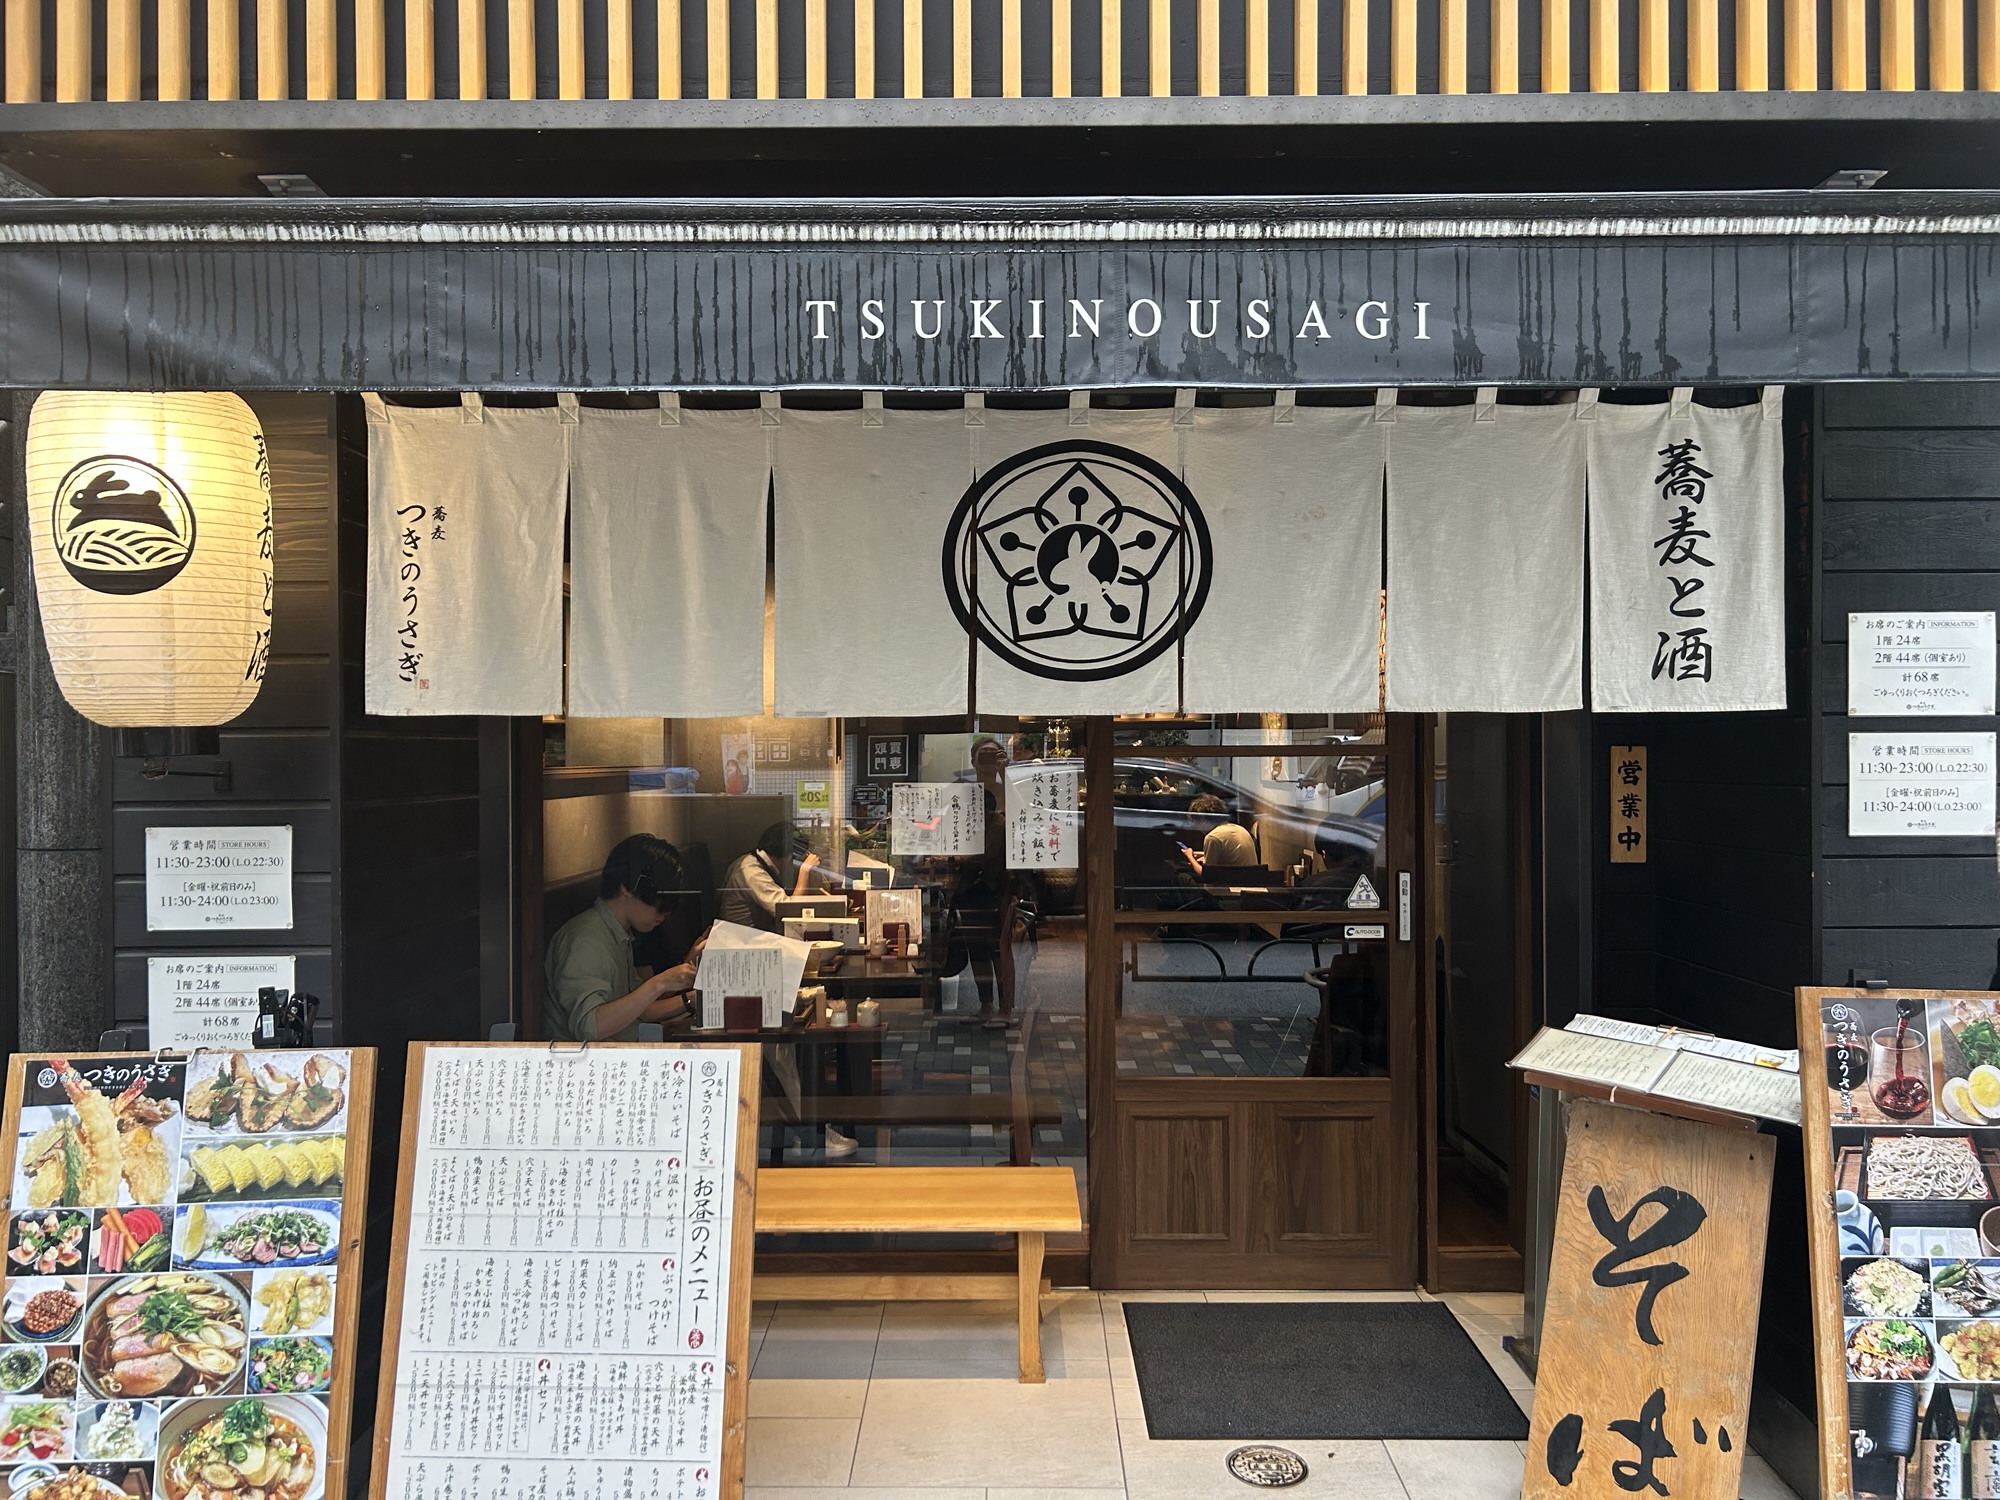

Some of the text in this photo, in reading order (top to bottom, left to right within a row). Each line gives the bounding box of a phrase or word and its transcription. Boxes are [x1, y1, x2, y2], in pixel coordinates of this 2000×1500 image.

[806, 299, 1432, 341] TSUKINOUSAGI
[430, 505, 448, 541] 蕎麦
[1651, 438, 1715, 683] 蕎麦と酒
[396, 503, 427, 682] つきのうさぎ
[1865, 619, 1976, 630] お席のご案内 INFORMATION
[1876, 635, 1921, 646] 1階 24席
[1875, 653, 1892, 663] 2階
[1895, 653, 1920, 663] 44席
[1873, 687, 1969, 698] ごゆっくりおくつろぎください。
[1872, 745, 1920, 757] 営業時間
[1019, 808, 1027, 863] お付けできます
[1032, 773, 1045, 862] 炊き込みご飯を
[1048, 773, 1061, 862] お蕎麦に無料で
[1615, 760, 1644, 852] 営業中
[169, 839, 217, 850] 営業時間
[166, 964, 275, 974] お席のご案内 INFORMATION
[176, 980, 220, 990] 1階 24席
[175, 997, 192, 1007] 2階
[196, 997, 220, 1007] 44席
[84, 1063, 174, 1085] つきのうさぎ
[472, 1058, 484, 1117] 天ぷらせいろ
[495, 1058, 507, 1117] 穴子天せいろ
[544, 1059, 554, 1097] 鴨せいろ
[564, 1059, 576, 1127] かしわ天せいろ
[660, 1060, 670, 1100] 十割そば
[1832, 1021, 1855, 1110] つきのうさぎ
[449, 1058, 461, 1136] よくばり天せいろ
[585, 1059, 595, 1134] くるみだれせいろ
[615, 1059, 627, 1146] おためし二色せいろ
[671, 1074, 685, 1139] 冷たいそば
[699, 1078, 716, 1162] つきのうさぎ
[444, 1156, 457, 1241] よくばり天ぷらそば
[496, 1157, 508, 1206] 天ぷらそば
[522, 1157, 534, 1207] 穴子天そば
[584, 1157, 594, 1187] 肉そば
[607, 1158, 617, 1207] カレーそば
[631, 1158, 641, 1207] きつねそば
[654, 1158, 663, 1198] かけそば
[545, 1178, 557, 1239] かきあげそば
[665, 1173, 680, 1239] 温かいそば
[687, 1175, 716, 1325] お昼のメニュー
[460, 1281, 472, 1341] ぶっかけそば
[471, 1268, 484, 1340] かきあげおろし
[521, 1257, 533, 1331] 海老天冷おろし
[576, 1258, 589, 1342] 野菜天カレーそば
[605, 1258, 618, 1338] 納豆ぶっかけそば
[635, 1259, 645, 1311] 山かけそば
[509, 1288, 521, 1347] ぶっかけそば
[647, 1299, 661, 1346] つけそば
[1546, 1185, 1734, 1498] そば
[419, 1357, 430, 1429] ミニ天丼セット
[443, 1357, 456, 1450] ミニ穴子天丼セット
[470, 1358, 482, 1450] ミニかきあげ丼セット
[496, 1358, 508, 1451] ミニしらす丼セット
[538, 1372, 549, 1424] 丼セット
[572, 1359, 586, 1447] 海老と野菜の天丼
[615, 1361, 628, 1434] 海鮮かきあげ丼
[650, 1361, 663, 1448] 穴子と野菜の天丼
